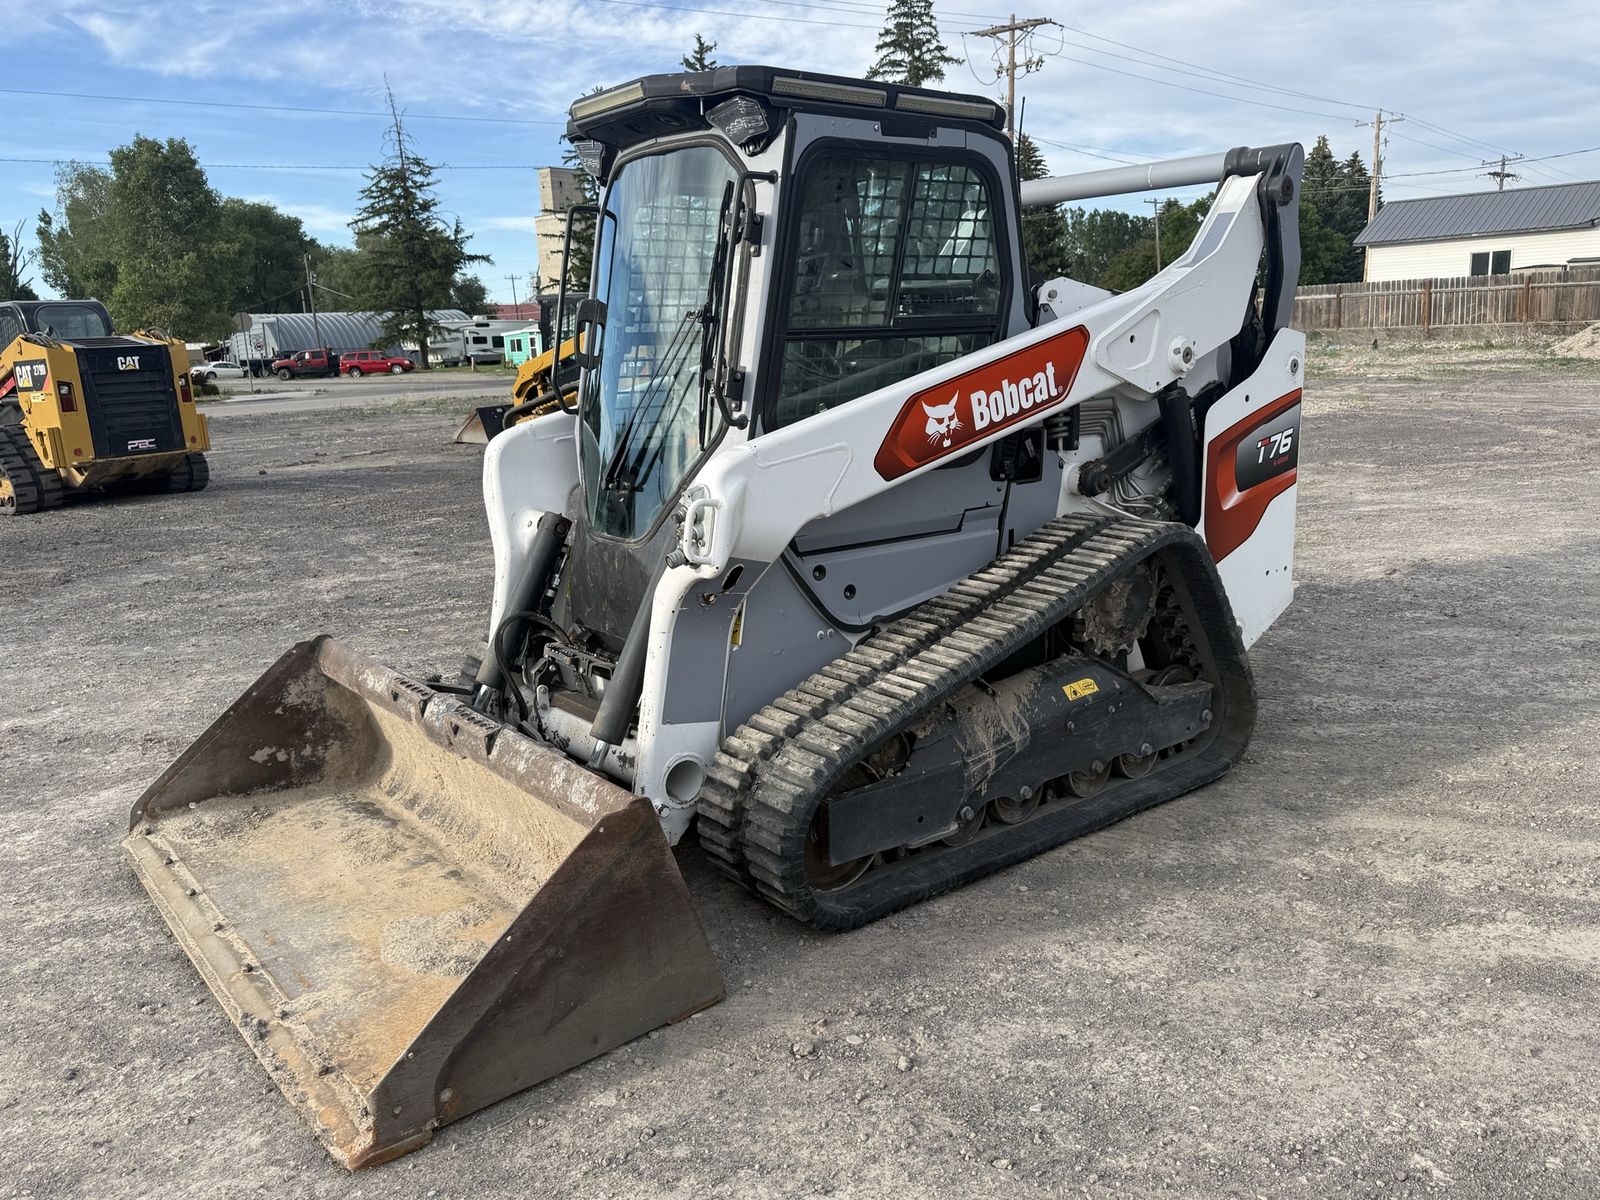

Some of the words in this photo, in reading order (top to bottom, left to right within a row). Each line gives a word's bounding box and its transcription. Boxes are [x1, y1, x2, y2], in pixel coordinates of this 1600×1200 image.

[15, 365, 33, 388] CAT
[117, 356, 139, 370] CAT
[970, 361, 1058, 431] Bobcat
[1257, 427, 1294, 464] T76
